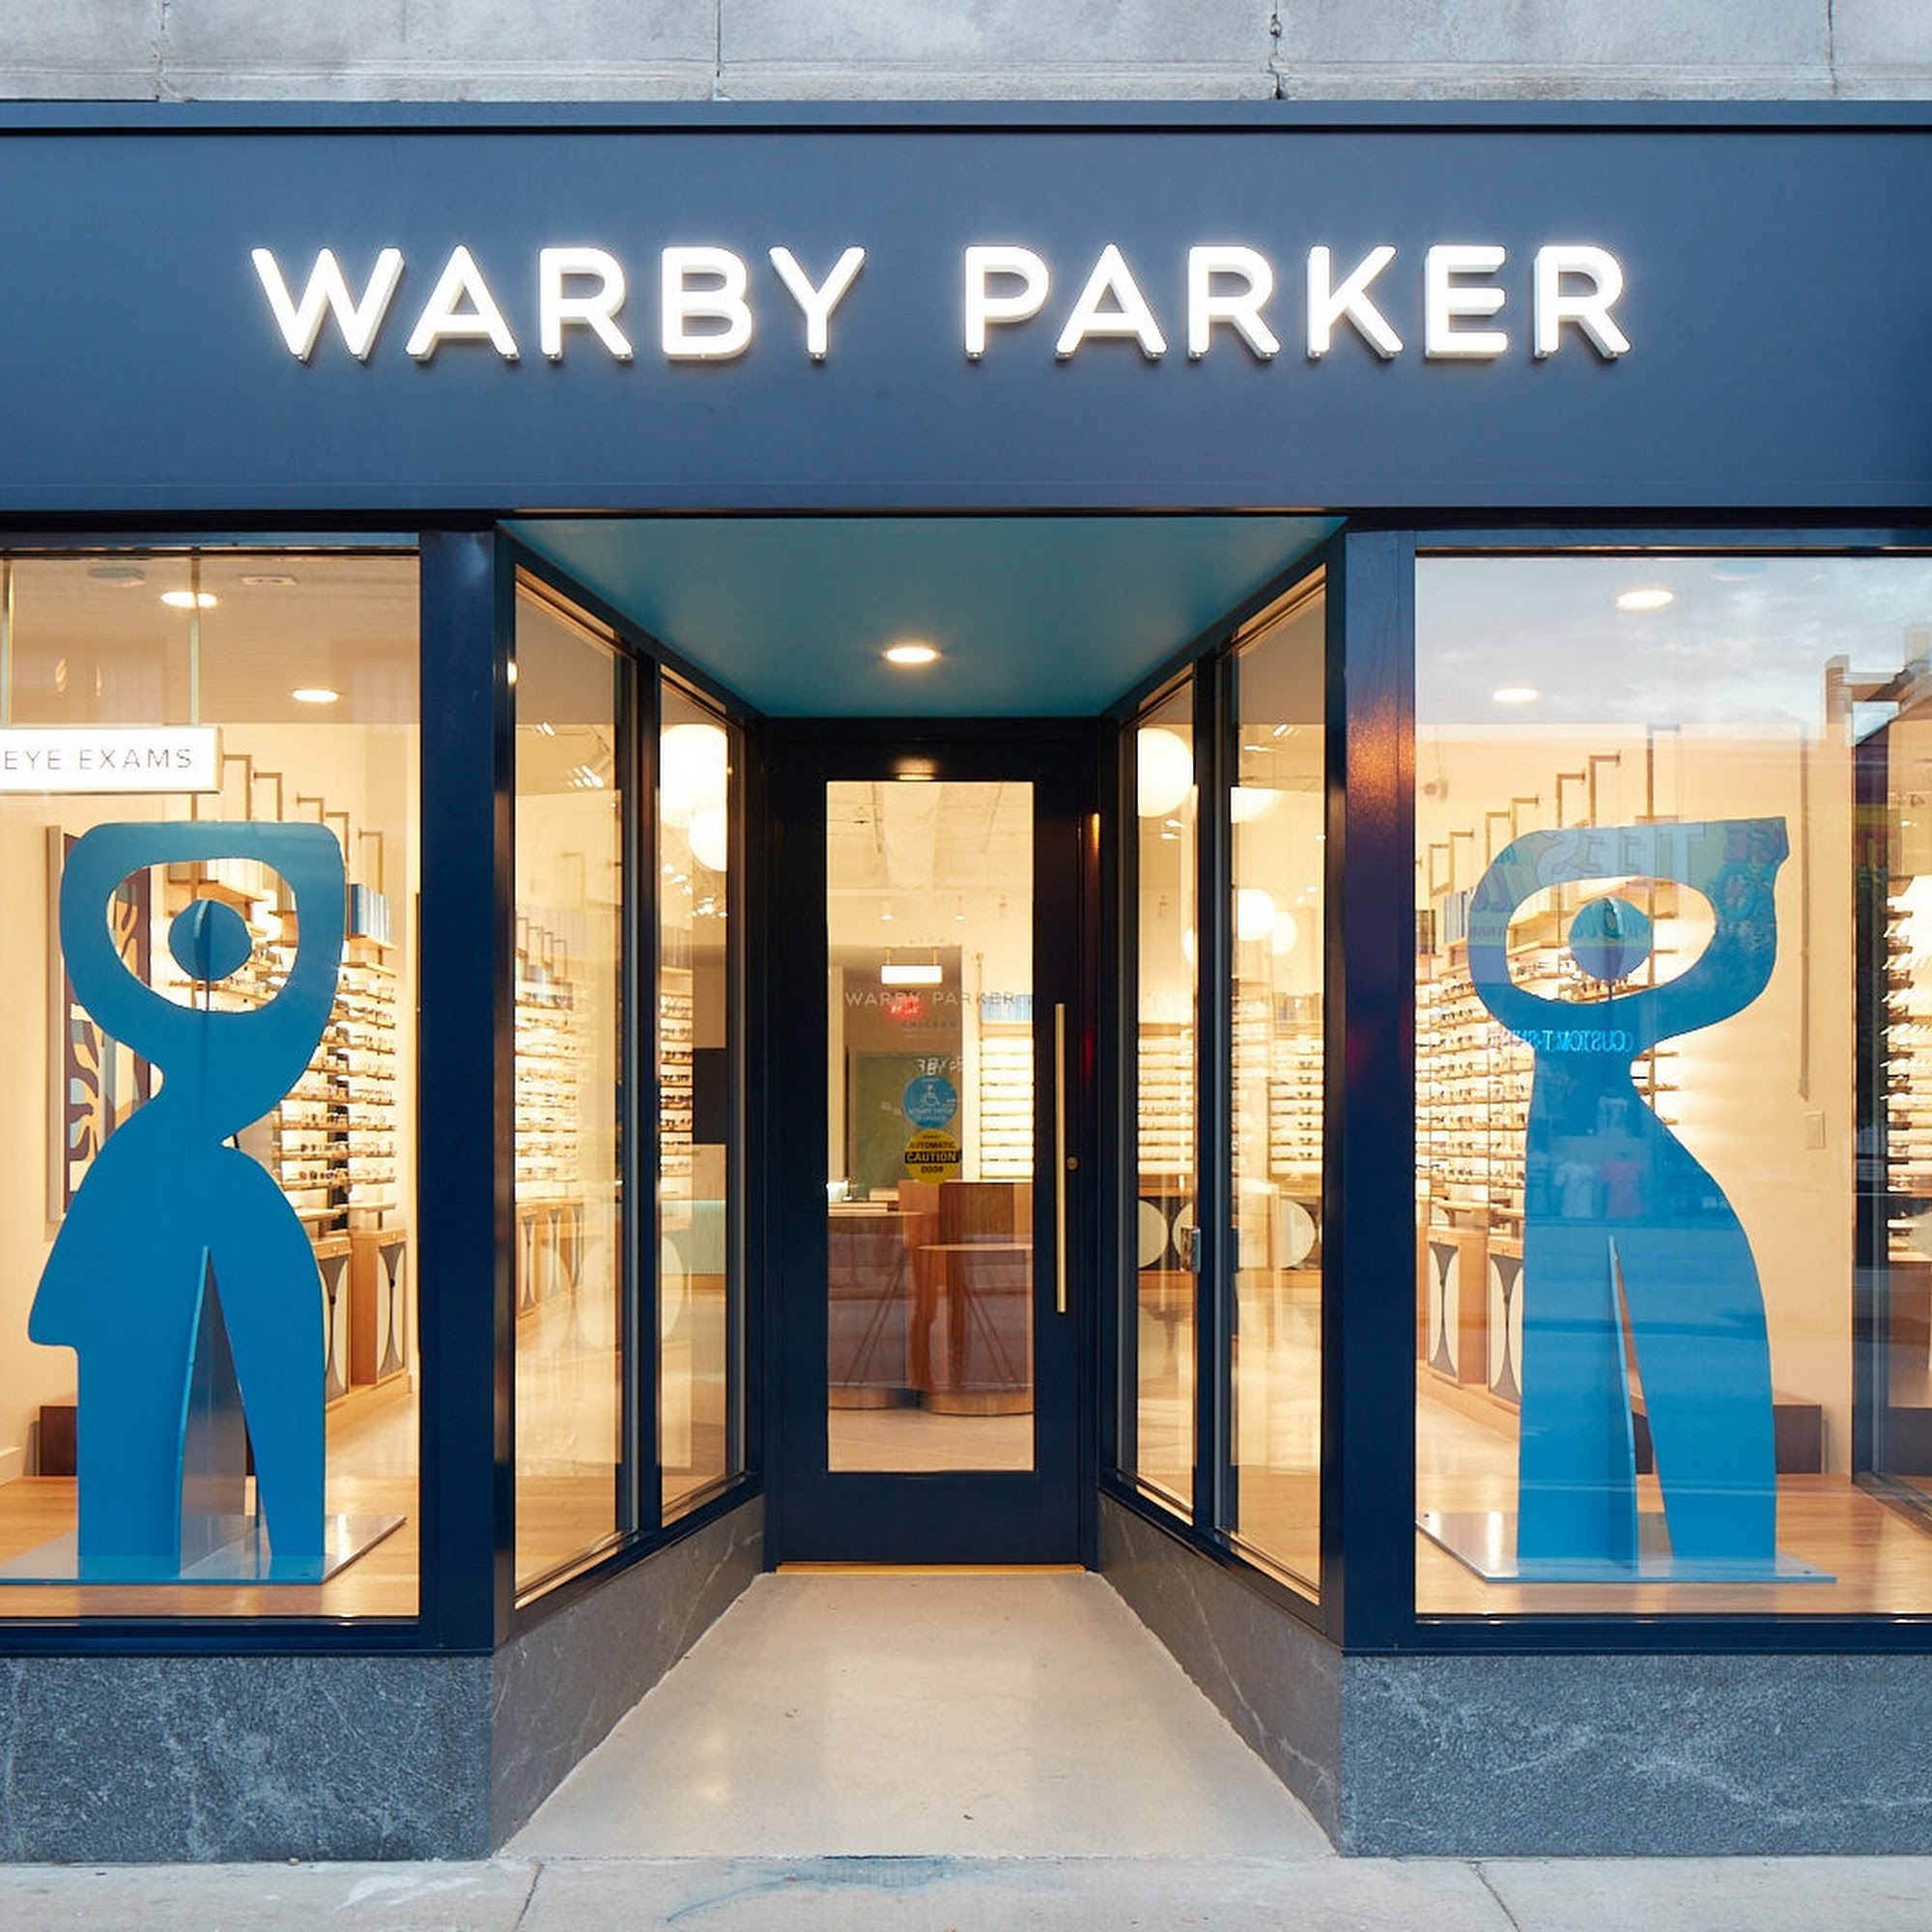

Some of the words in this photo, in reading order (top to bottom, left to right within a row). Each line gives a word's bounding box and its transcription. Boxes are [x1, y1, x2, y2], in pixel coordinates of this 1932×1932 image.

[251, 245, 866, 361] WARBY
[965, 243, 1631, 361] PARKER
[4, 750, 62, 770] EYE
[79, 748, 192, 769] EXAMS
[906, 1152, 957, 1163] CAUTION
